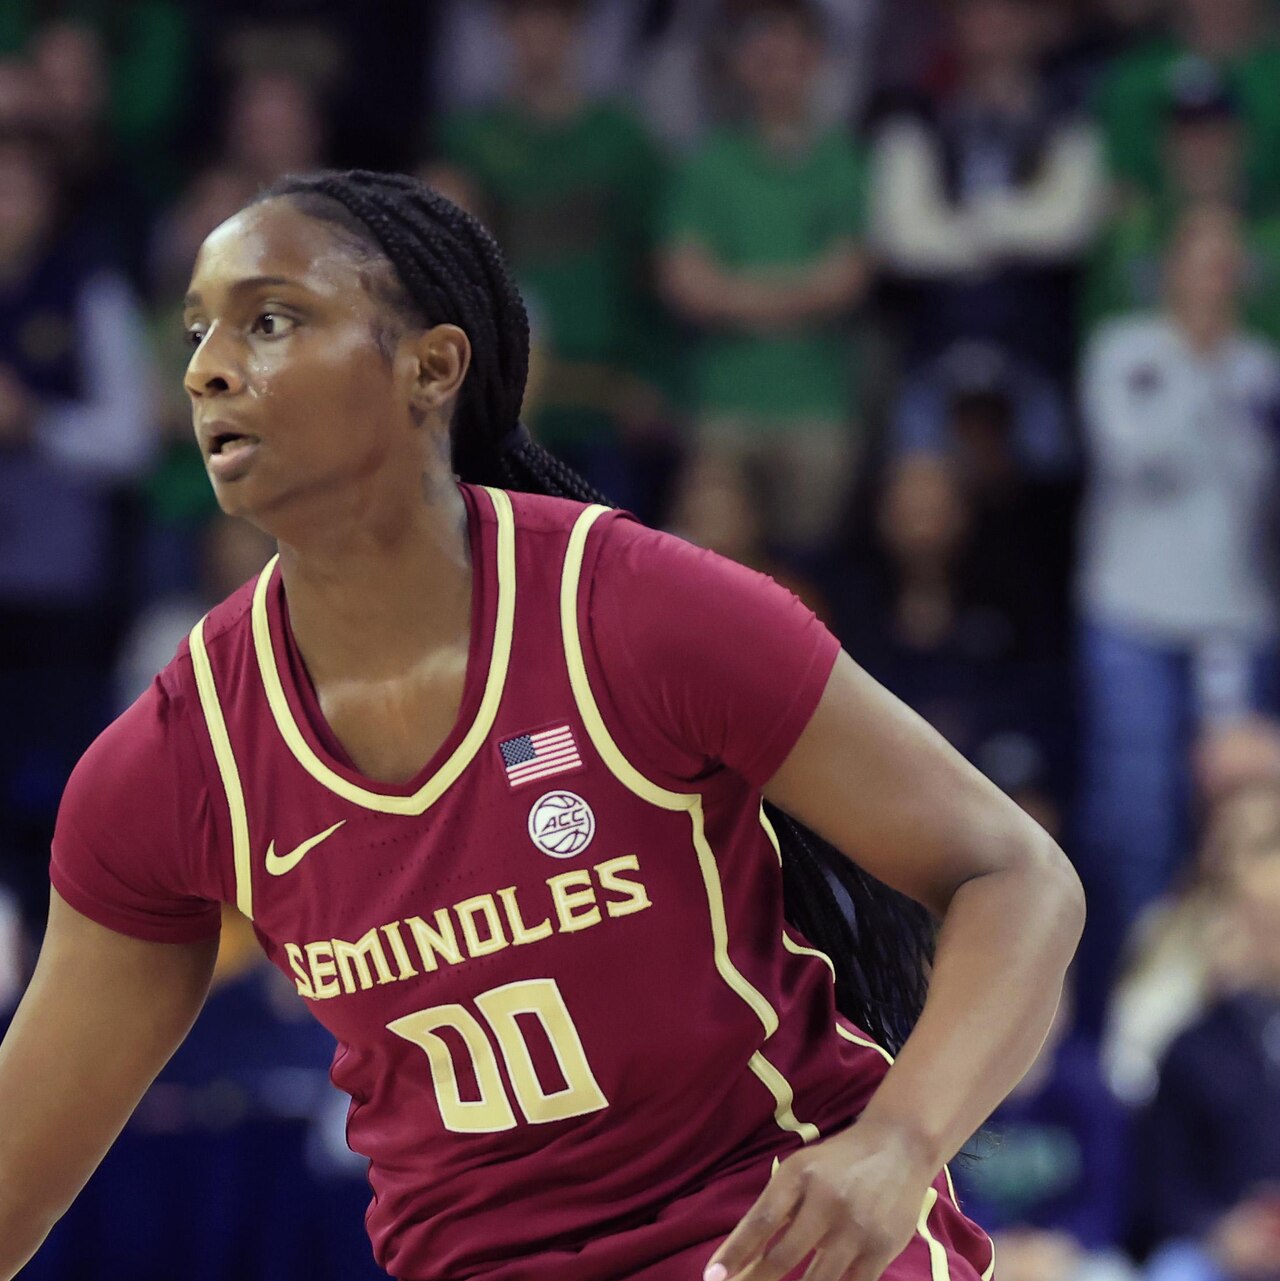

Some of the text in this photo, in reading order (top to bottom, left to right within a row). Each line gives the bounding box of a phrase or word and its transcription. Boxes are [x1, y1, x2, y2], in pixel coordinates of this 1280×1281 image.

[541, 806, 585, 832] ACC
[283, 854, 653, 1001] SEMINOLES
[386, 977, 610, 1134] 00
